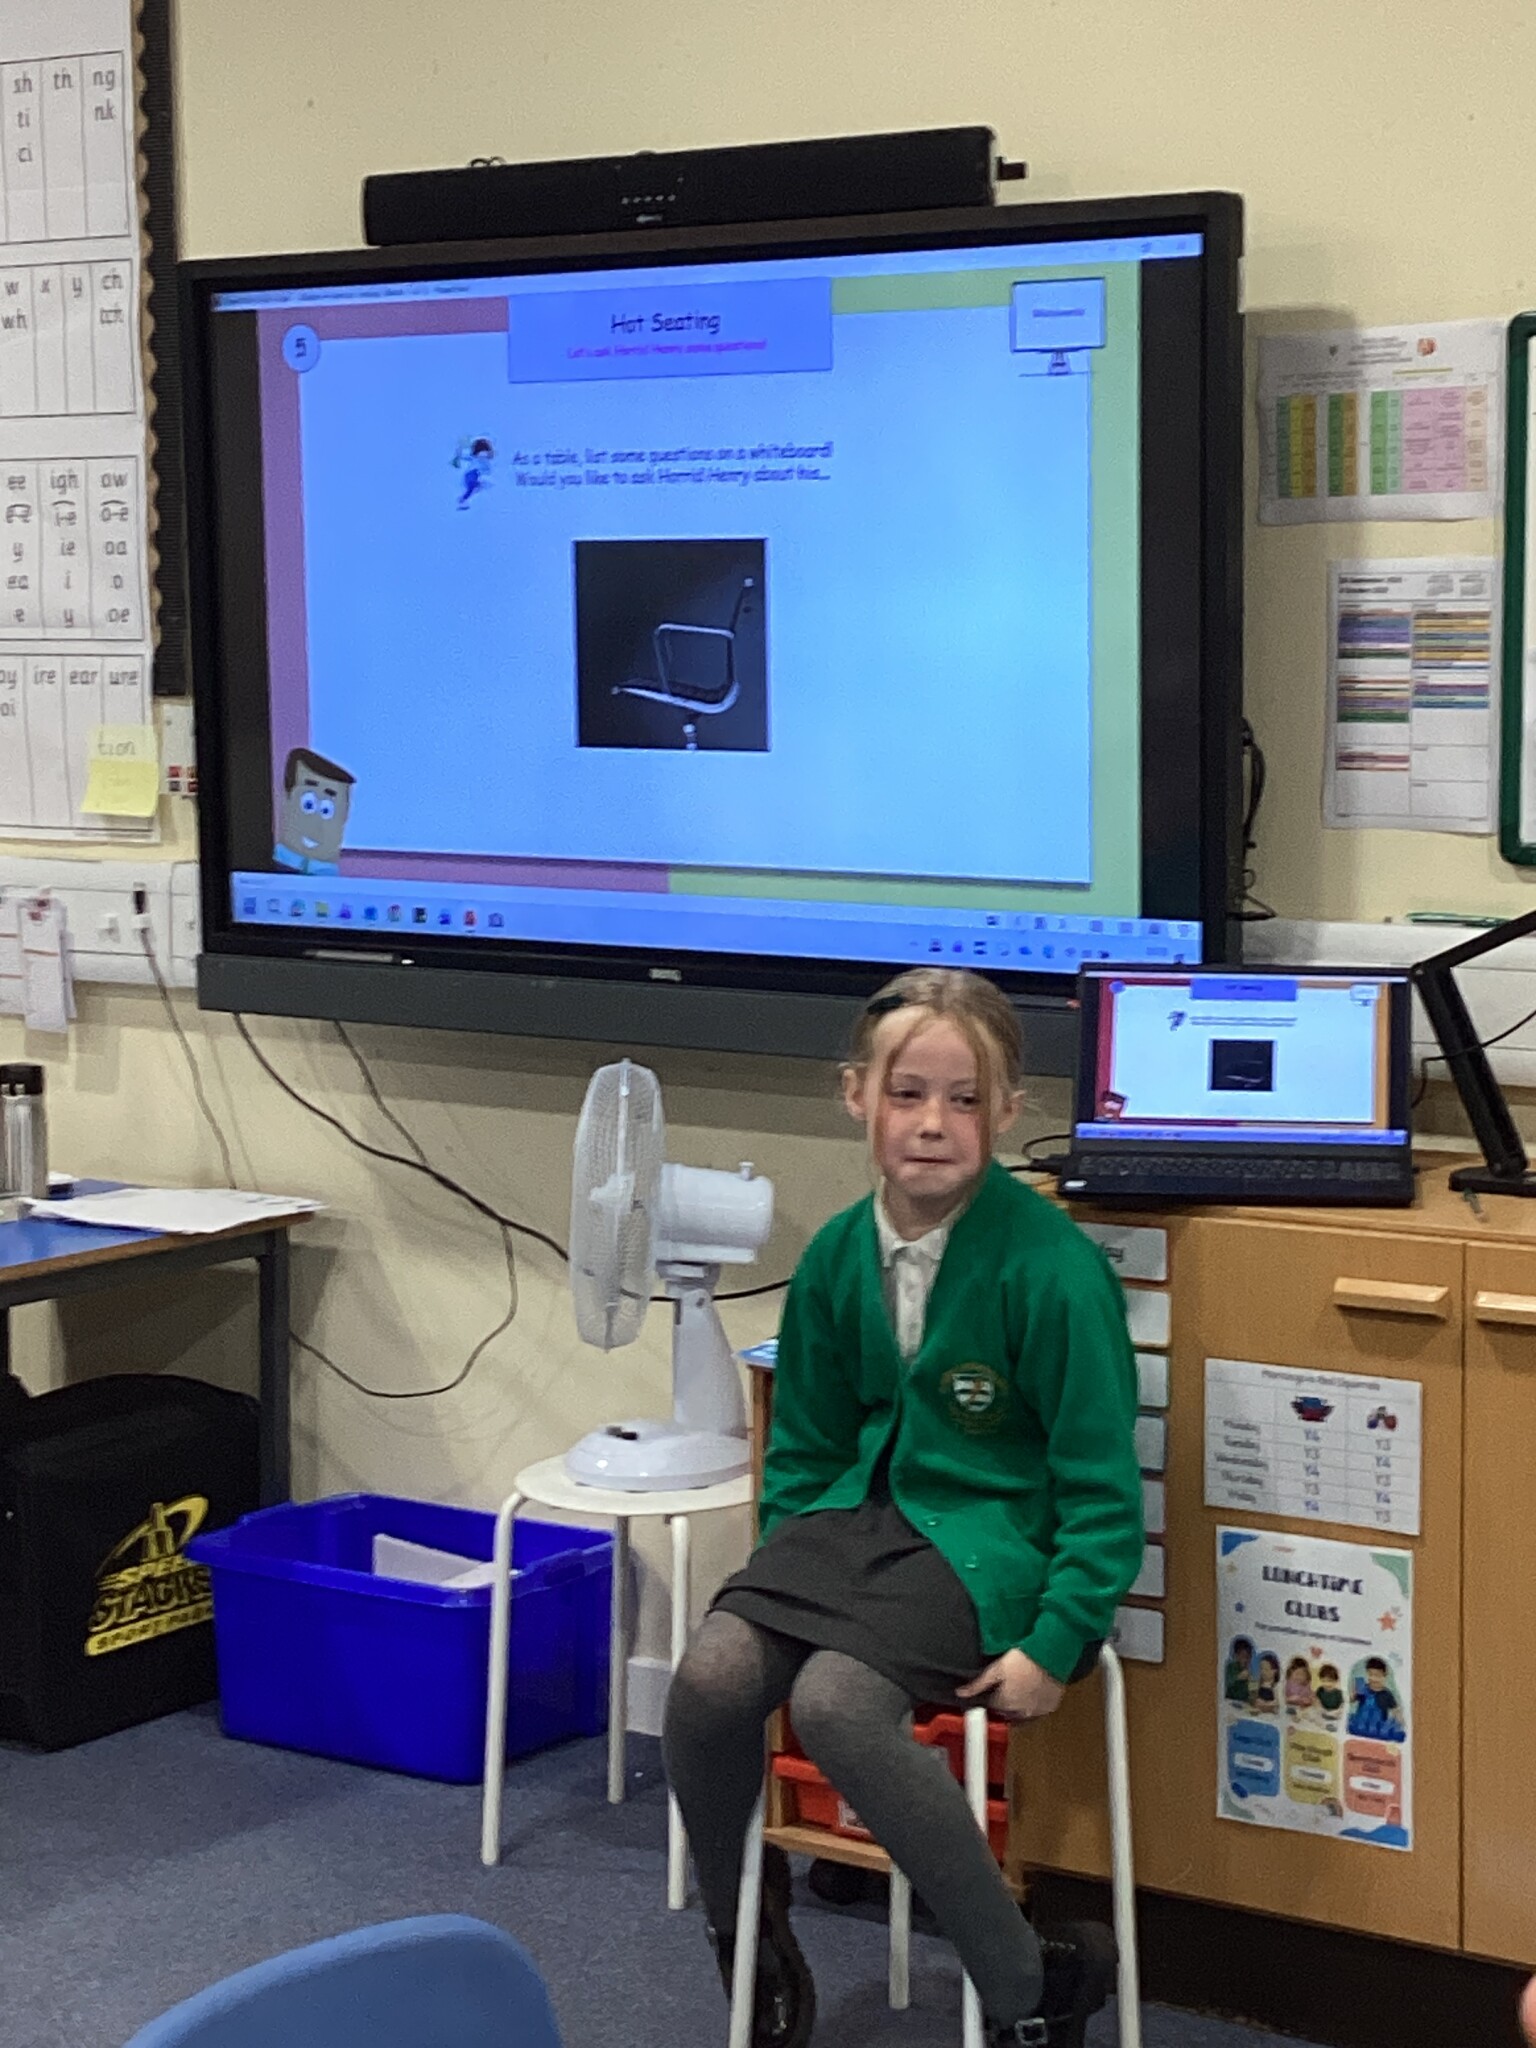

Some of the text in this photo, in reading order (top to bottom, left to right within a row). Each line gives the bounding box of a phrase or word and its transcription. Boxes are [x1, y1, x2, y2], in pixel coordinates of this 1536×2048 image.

[13, 71, 33, 94] sh
[53, 67, 73, 90] th
[93, 69, 115, 91] ng
[94, 98, 116, 121] nk
[72, 277, 82, 298] y
[611, 310, 721, 335] Hot Seating
[34, 665, 56, 685] ire
[69, 670, 98, 685] ear
[1285, 1600, 1340, 1622] CLUBS
